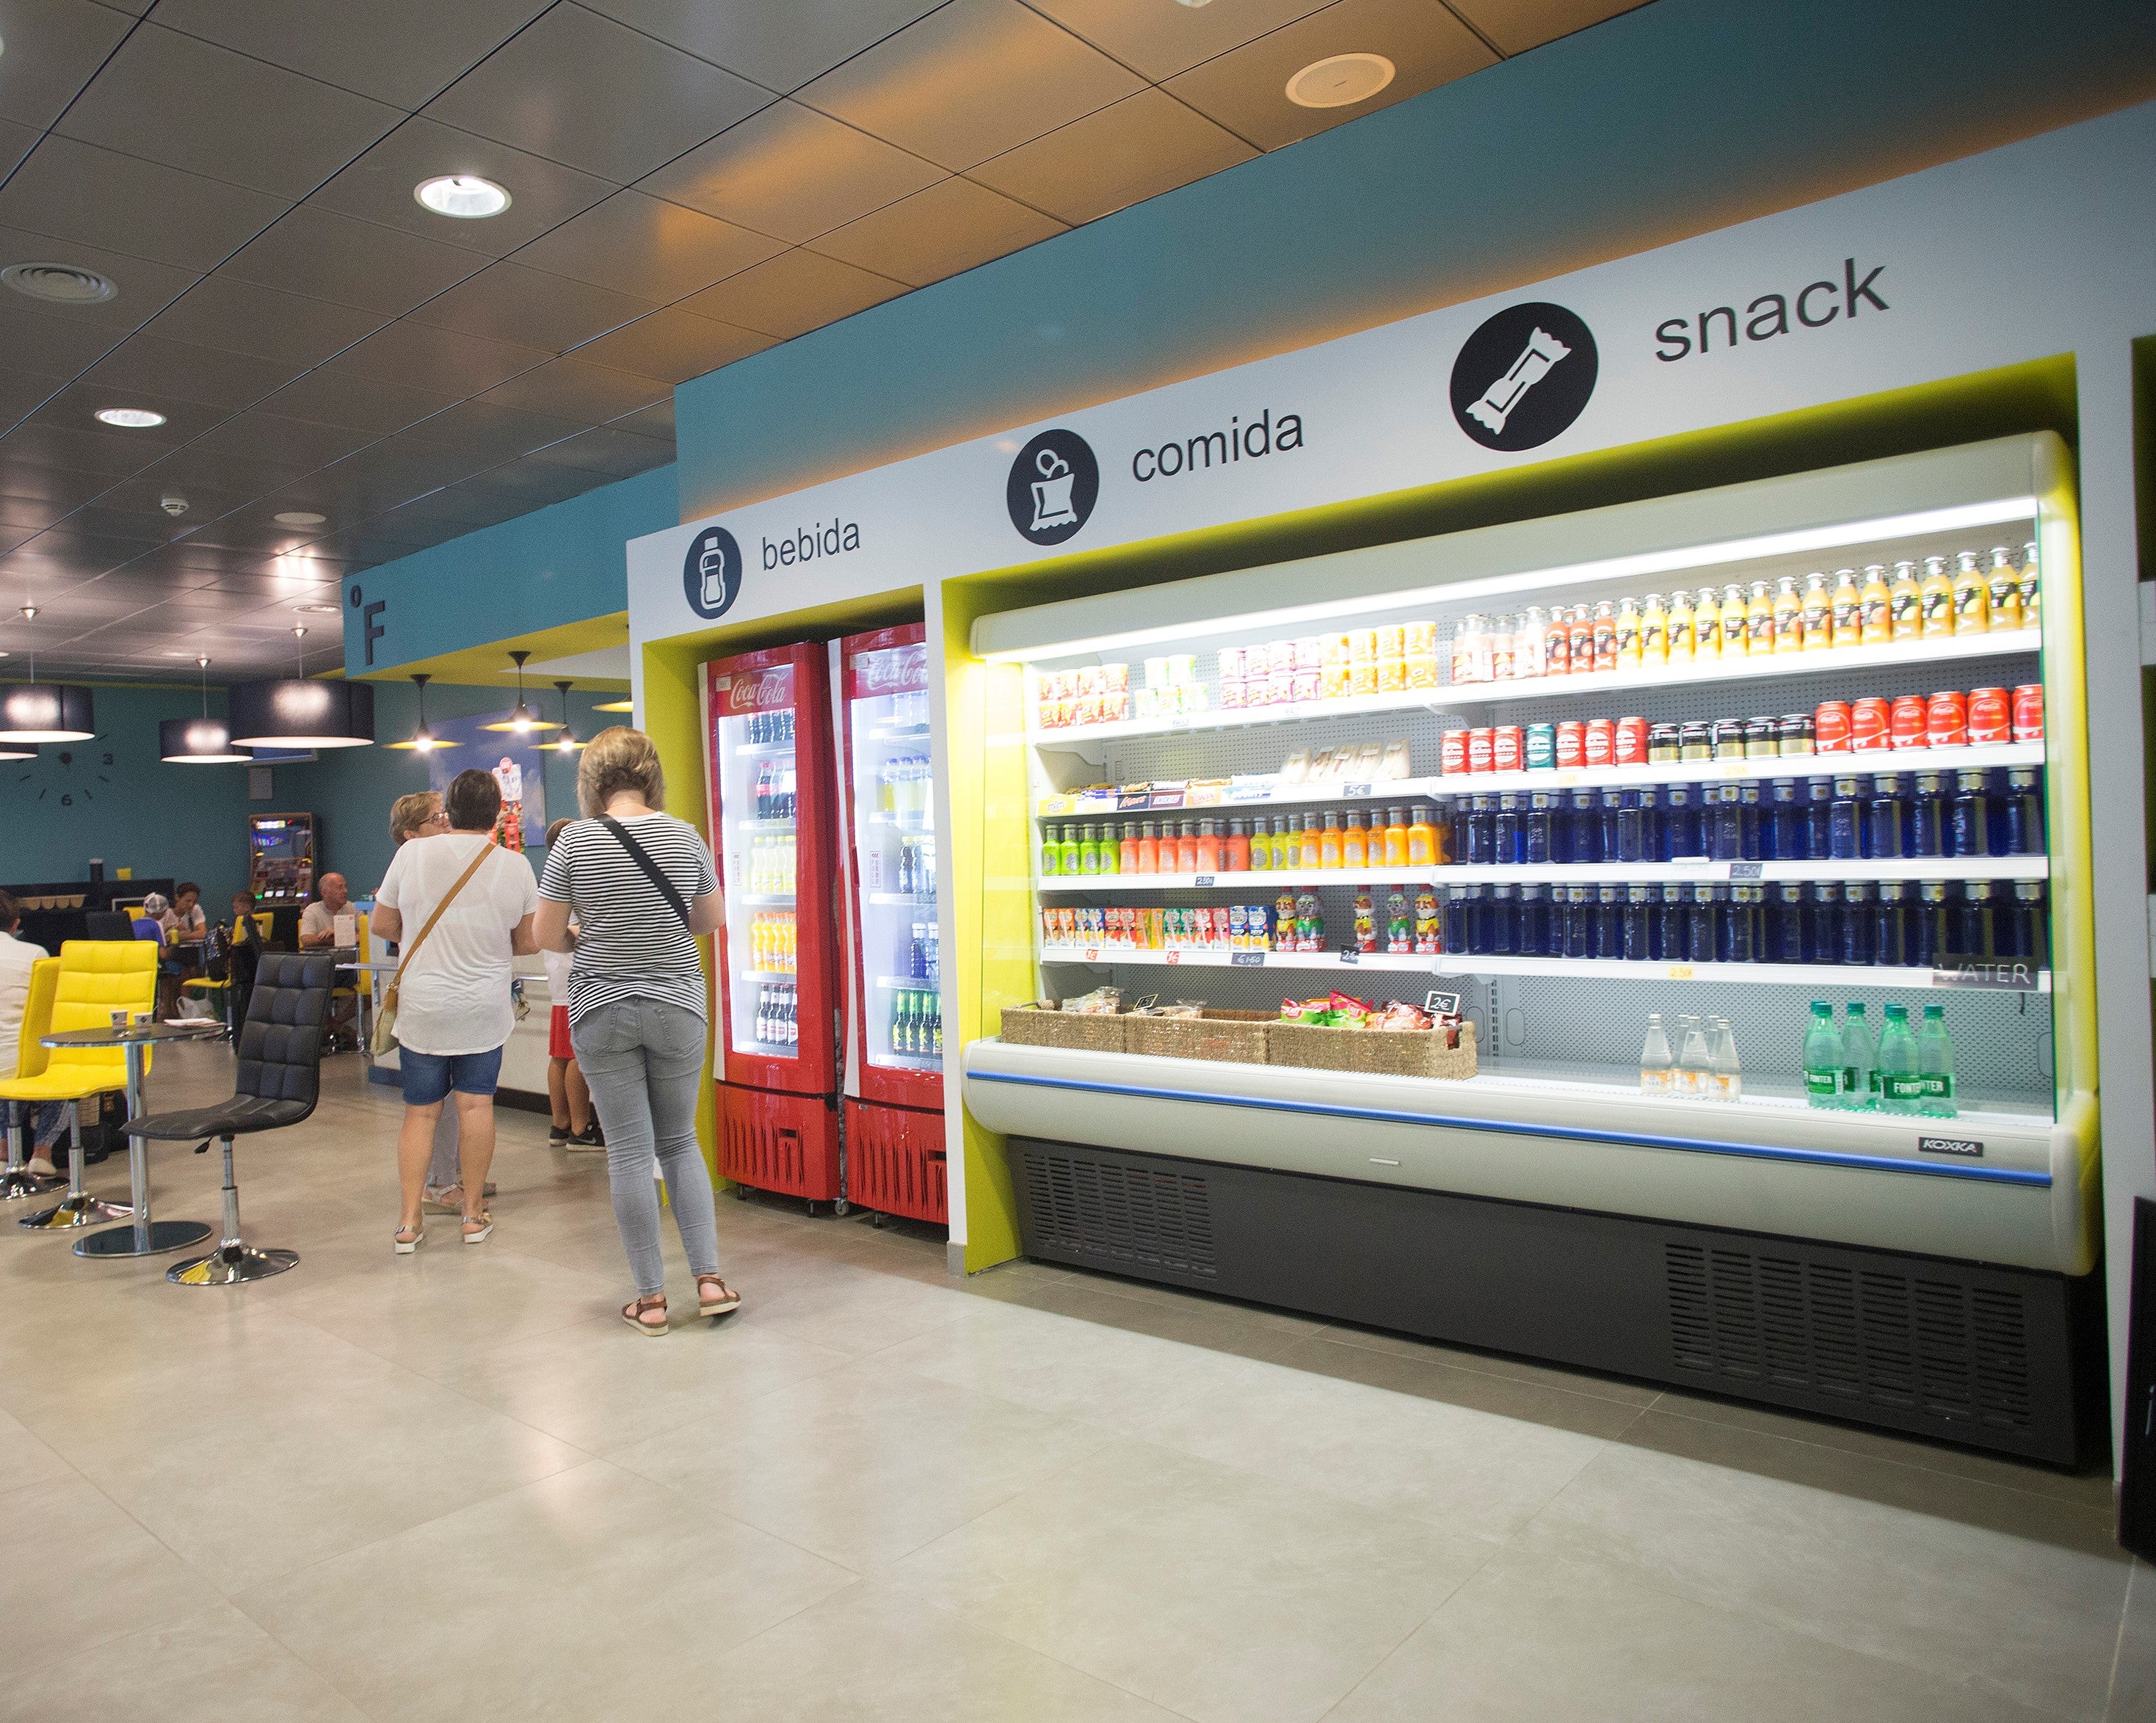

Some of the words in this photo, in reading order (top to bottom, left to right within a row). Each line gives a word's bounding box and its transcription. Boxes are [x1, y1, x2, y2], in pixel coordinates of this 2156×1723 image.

[1655, 258, 1890, 362] snack
[1133, 409, 1304, 482] comida
[763, 518, 860, 570] bebida
[730, 671, 789, 709] Coca-Cola
[62, 794, 72, 806] 6
[1431, 997, 1452, 1011] 2€
[1923, 1139, 1977, 1153] KOXKA
